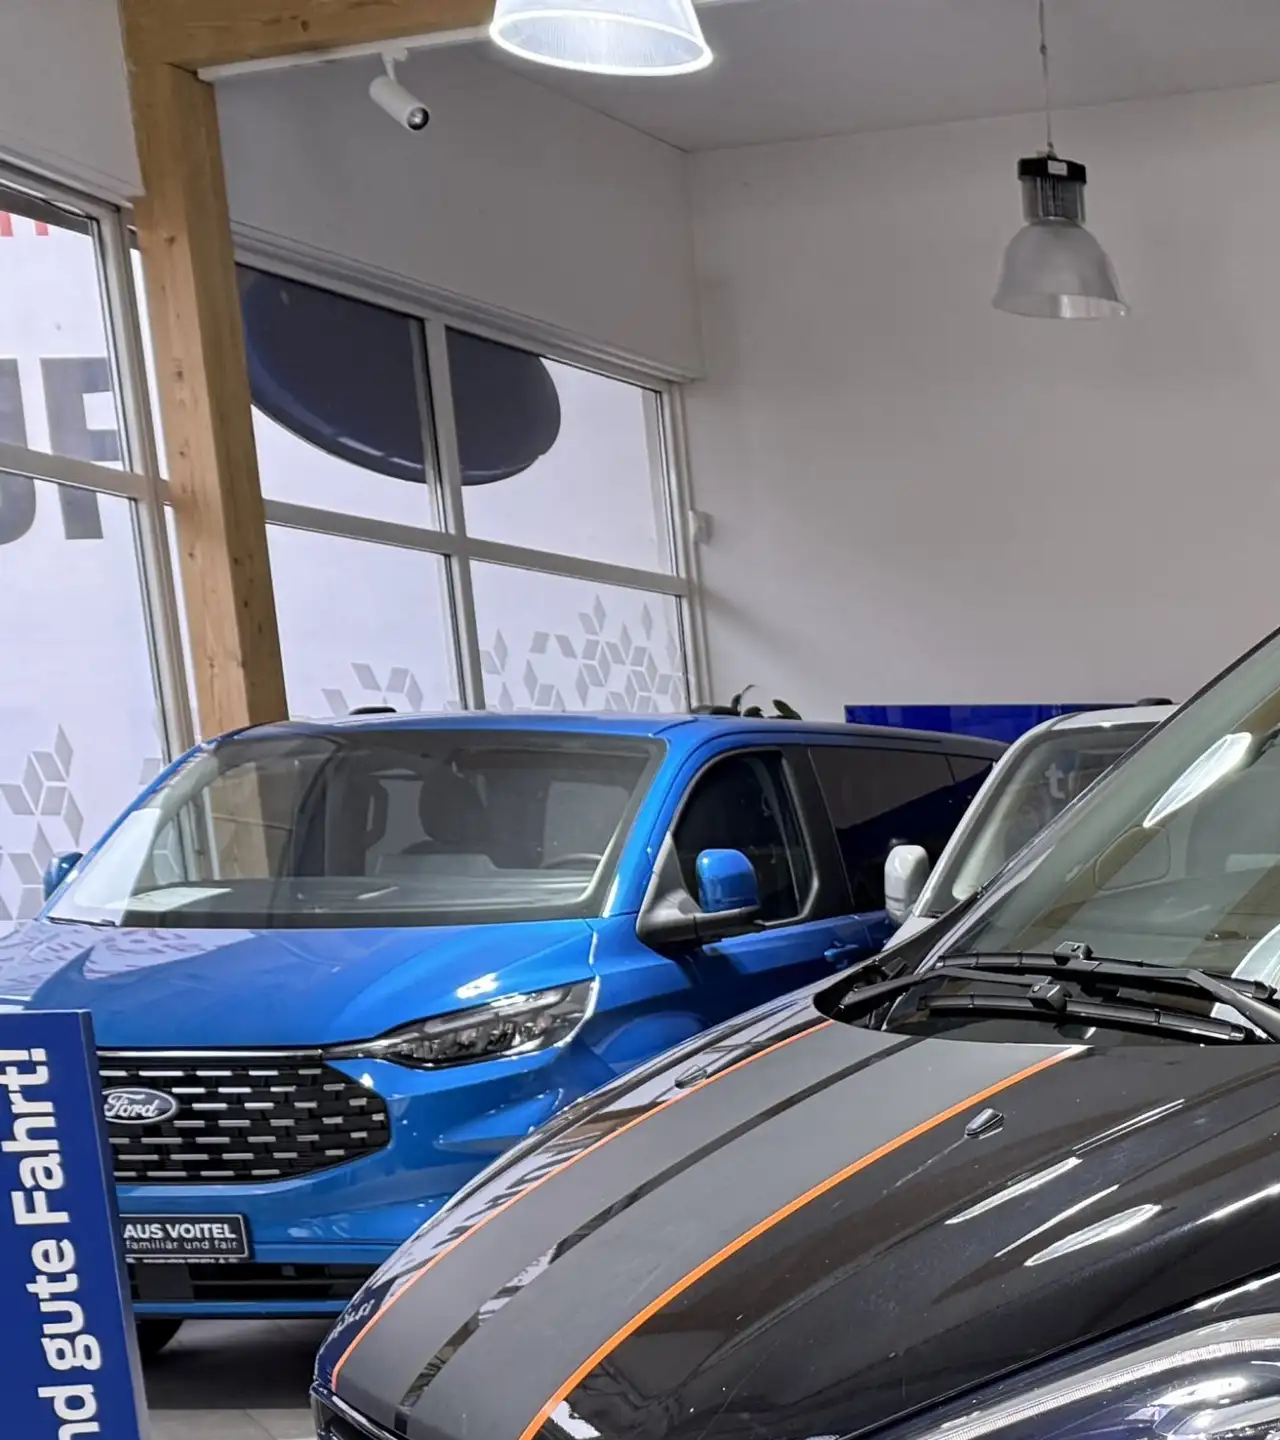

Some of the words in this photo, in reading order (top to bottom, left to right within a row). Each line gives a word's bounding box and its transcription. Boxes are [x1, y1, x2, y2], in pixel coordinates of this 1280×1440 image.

[103, 1092, 160, 1118] Ford
[0, 1047, 71, 1226] Fahrt!
[165, 1223, 237, 1239] VOITEL
[125, 1240, 179, 1251] familiär
[183, 1240, 210, 1250] und
[214, 1240, 239, 1250] fair
[25, 1238, 102, 1372] gute
